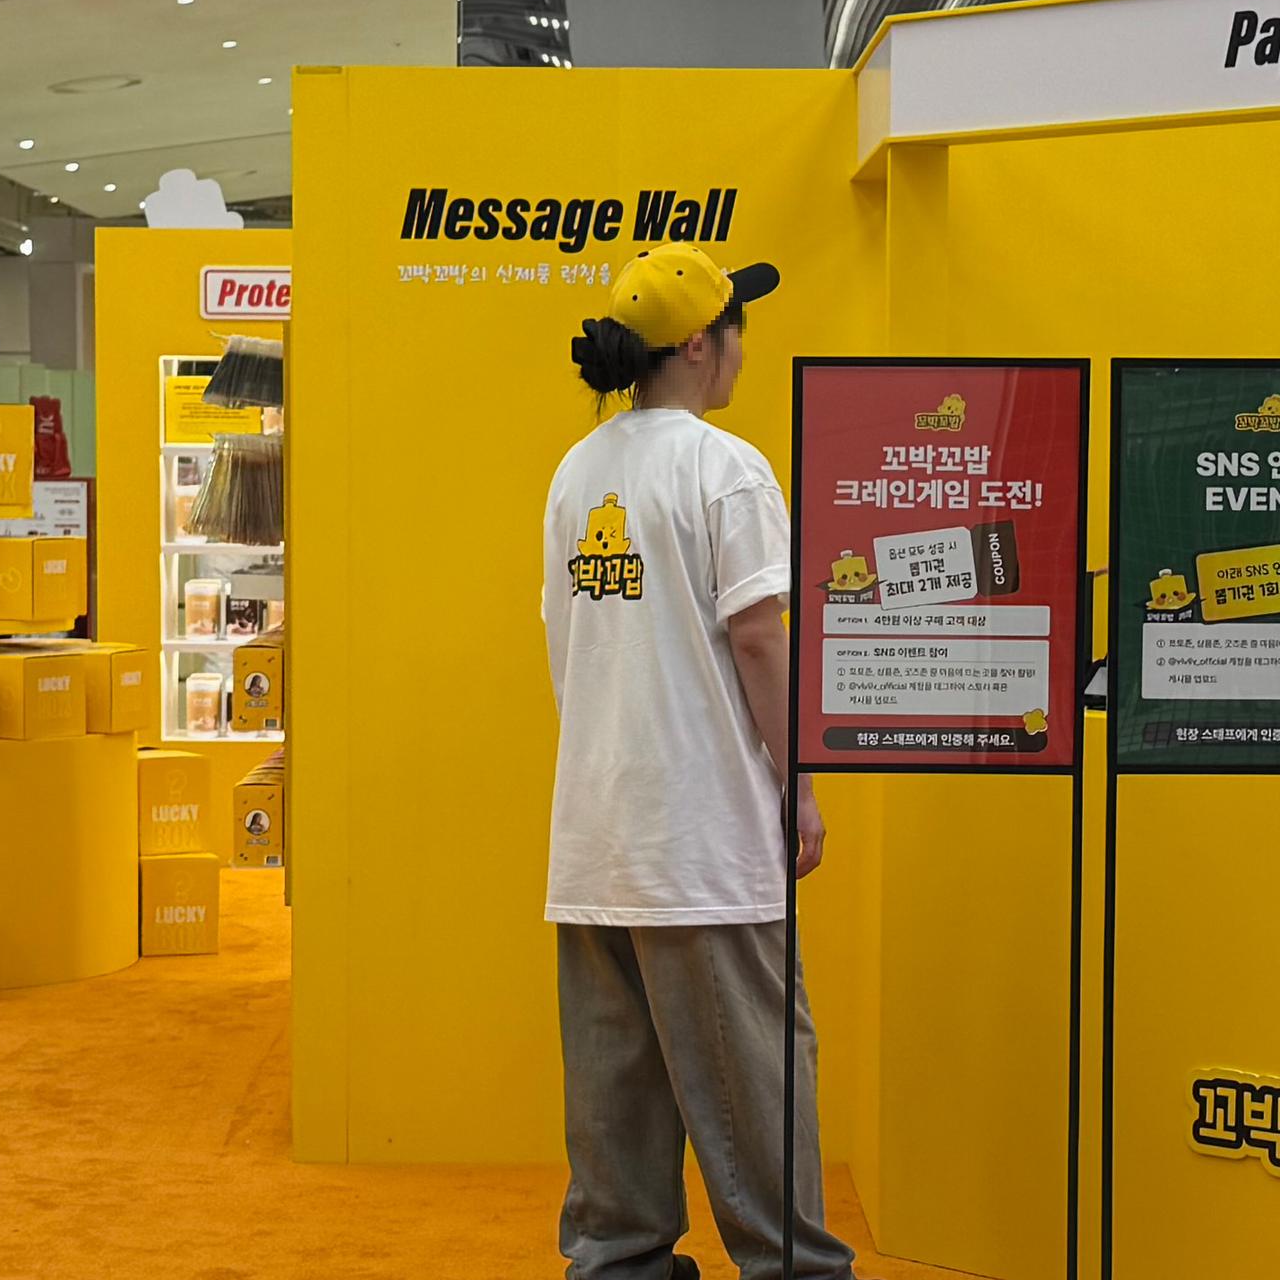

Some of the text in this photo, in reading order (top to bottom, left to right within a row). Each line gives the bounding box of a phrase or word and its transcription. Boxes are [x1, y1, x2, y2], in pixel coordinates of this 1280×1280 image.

[400, 188, 738, 253] Message Wall
[880, 445, 991, 475] 꼬박꼬밥
[1196, 452, 1260, 478] SNS
[833, 479, 1043, 510] 크레인게임 도전!
[988, 532, 1006, 586] COUPON
[1246, 565, 1269, 579] SNS
[886, 579, 915, 598] 최대
[919, 576, 942, 593] 2개
[946, 572, 973, 590] 제공
[38, 675, 71, 693] LUCKY
[151, 804, 200, 824] LUCKY
[155, 905, 207, 925] LUCKY
